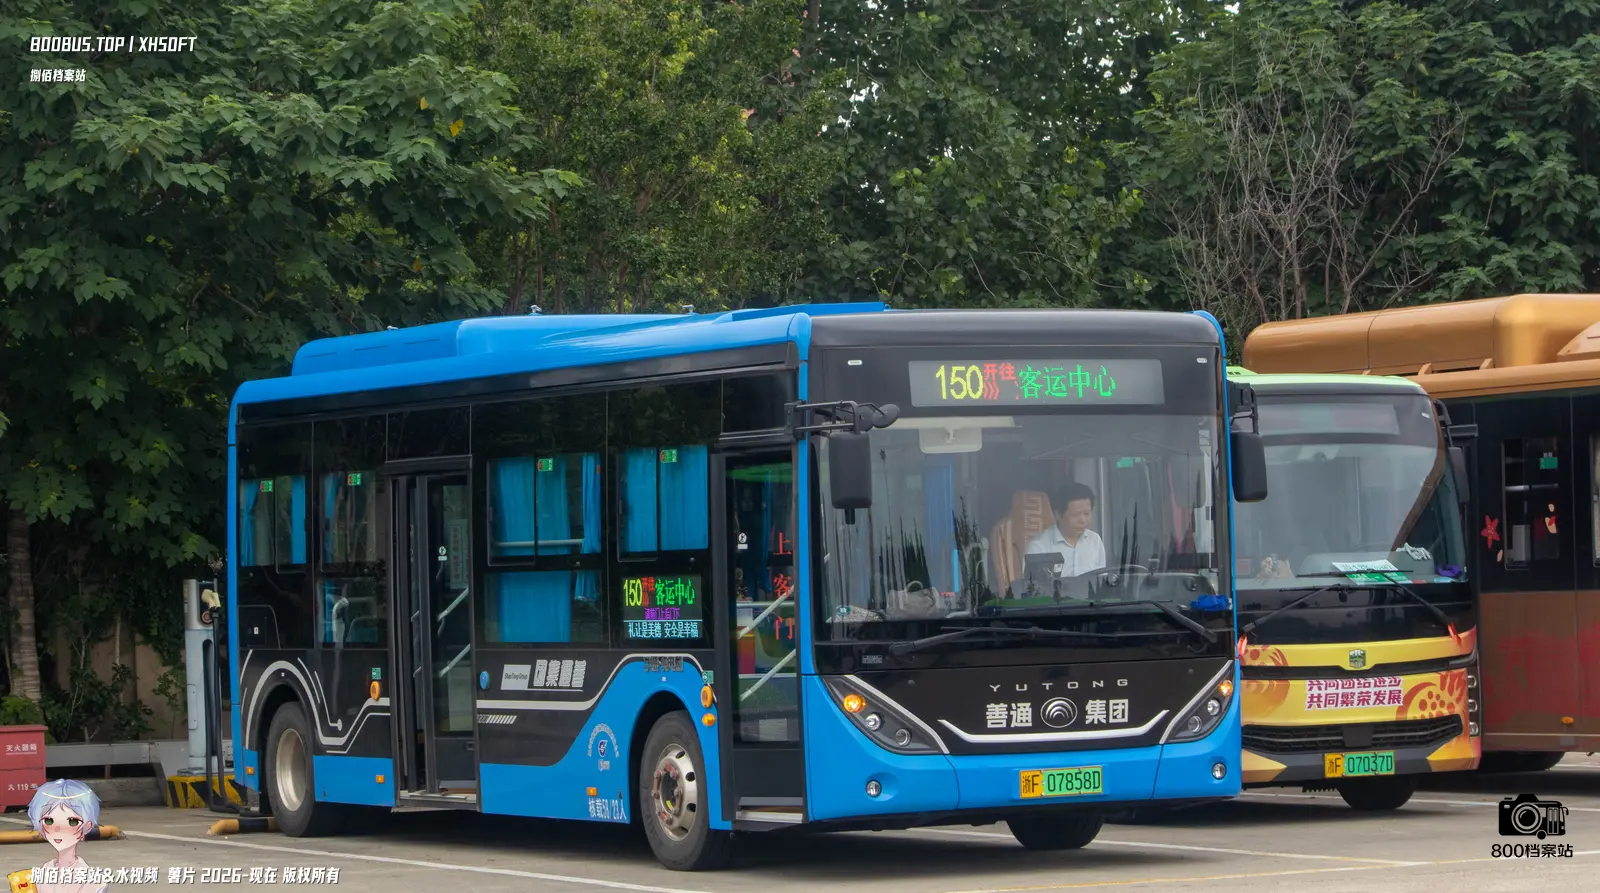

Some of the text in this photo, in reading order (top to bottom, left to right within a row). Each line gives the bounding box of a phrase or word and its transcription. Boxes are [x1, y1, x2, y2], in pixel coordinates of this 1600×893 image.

[935, 362, 1117, 400] 150 开往 客运中心
[623, 578, 642, 606] 150
[655, 577, 695, 606] 客运中心
[628, 621, 699, 638] 礼让是美德 安全是幸福
[989, 678, 1129, 693] YUTONG
[1307, 689, 1402, 710] 共同繁荣发展
[986, 698, 1129, 729] 善通 集团
[6, 743, 37, 752] 灭火器箱
[1347, 755, 1393, 773] 07037D
[17, 783, 29, 791] 119
[1047, 770, 1101, 792] 07858D
